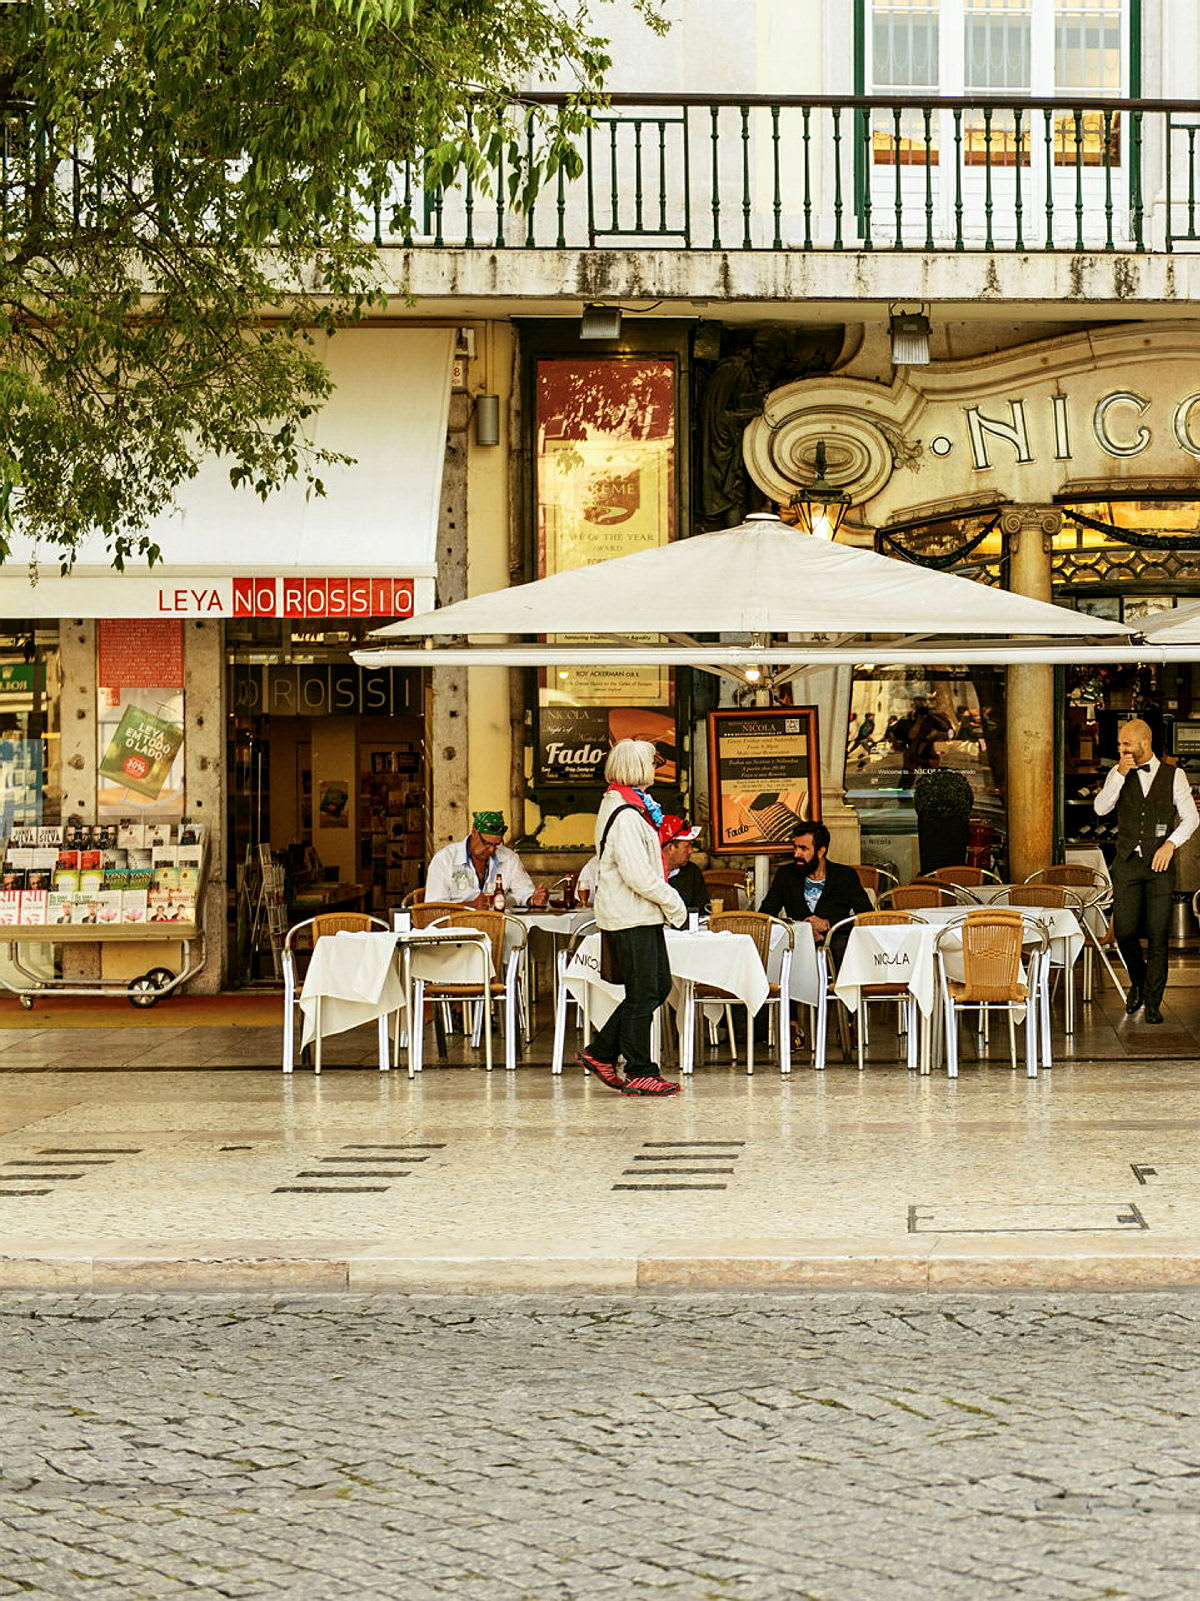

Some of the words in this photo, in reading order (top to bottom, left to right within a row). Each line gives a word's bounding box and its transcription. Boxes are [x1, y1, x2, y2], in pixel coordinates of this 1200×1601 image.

[159, 590, 223, 611] LEYA
[235, 590, 275, 612] NO
[286, 589, 413, 612] ROSSIO
[125, 727, 143, 742] EM
[142, 736, 171, 755] TODO
[138, 722, 165, 741] LEYA
[134, 742, 163, 760] LADO
[545, 742, 603, 765] Fado
[725, 825, 750, 838] Fado
